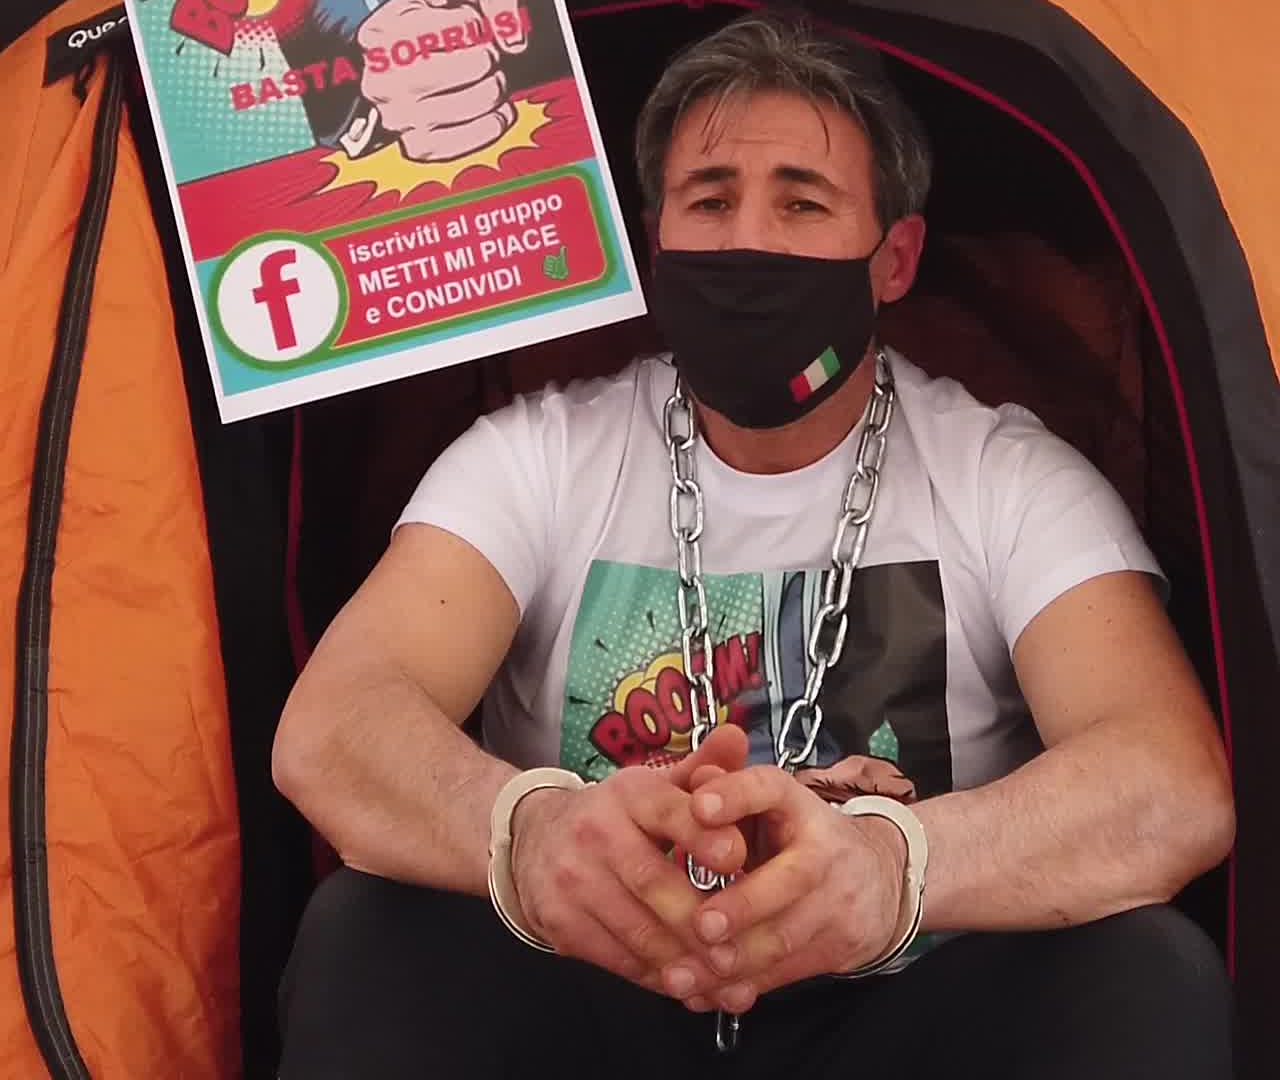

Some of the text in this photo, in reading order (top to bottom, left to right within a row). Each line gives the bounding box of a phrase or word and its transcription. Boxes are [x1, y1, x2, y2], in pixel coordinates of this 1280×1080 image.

[231, 7, 533, 112] BASTA SOPRUSI
[348, 193, 563, 264] iscriviti al gruppo
[359, 223, 560, 295] METTI MI PIACE
[366, 266, 521, 324] e CONDIVIDI
